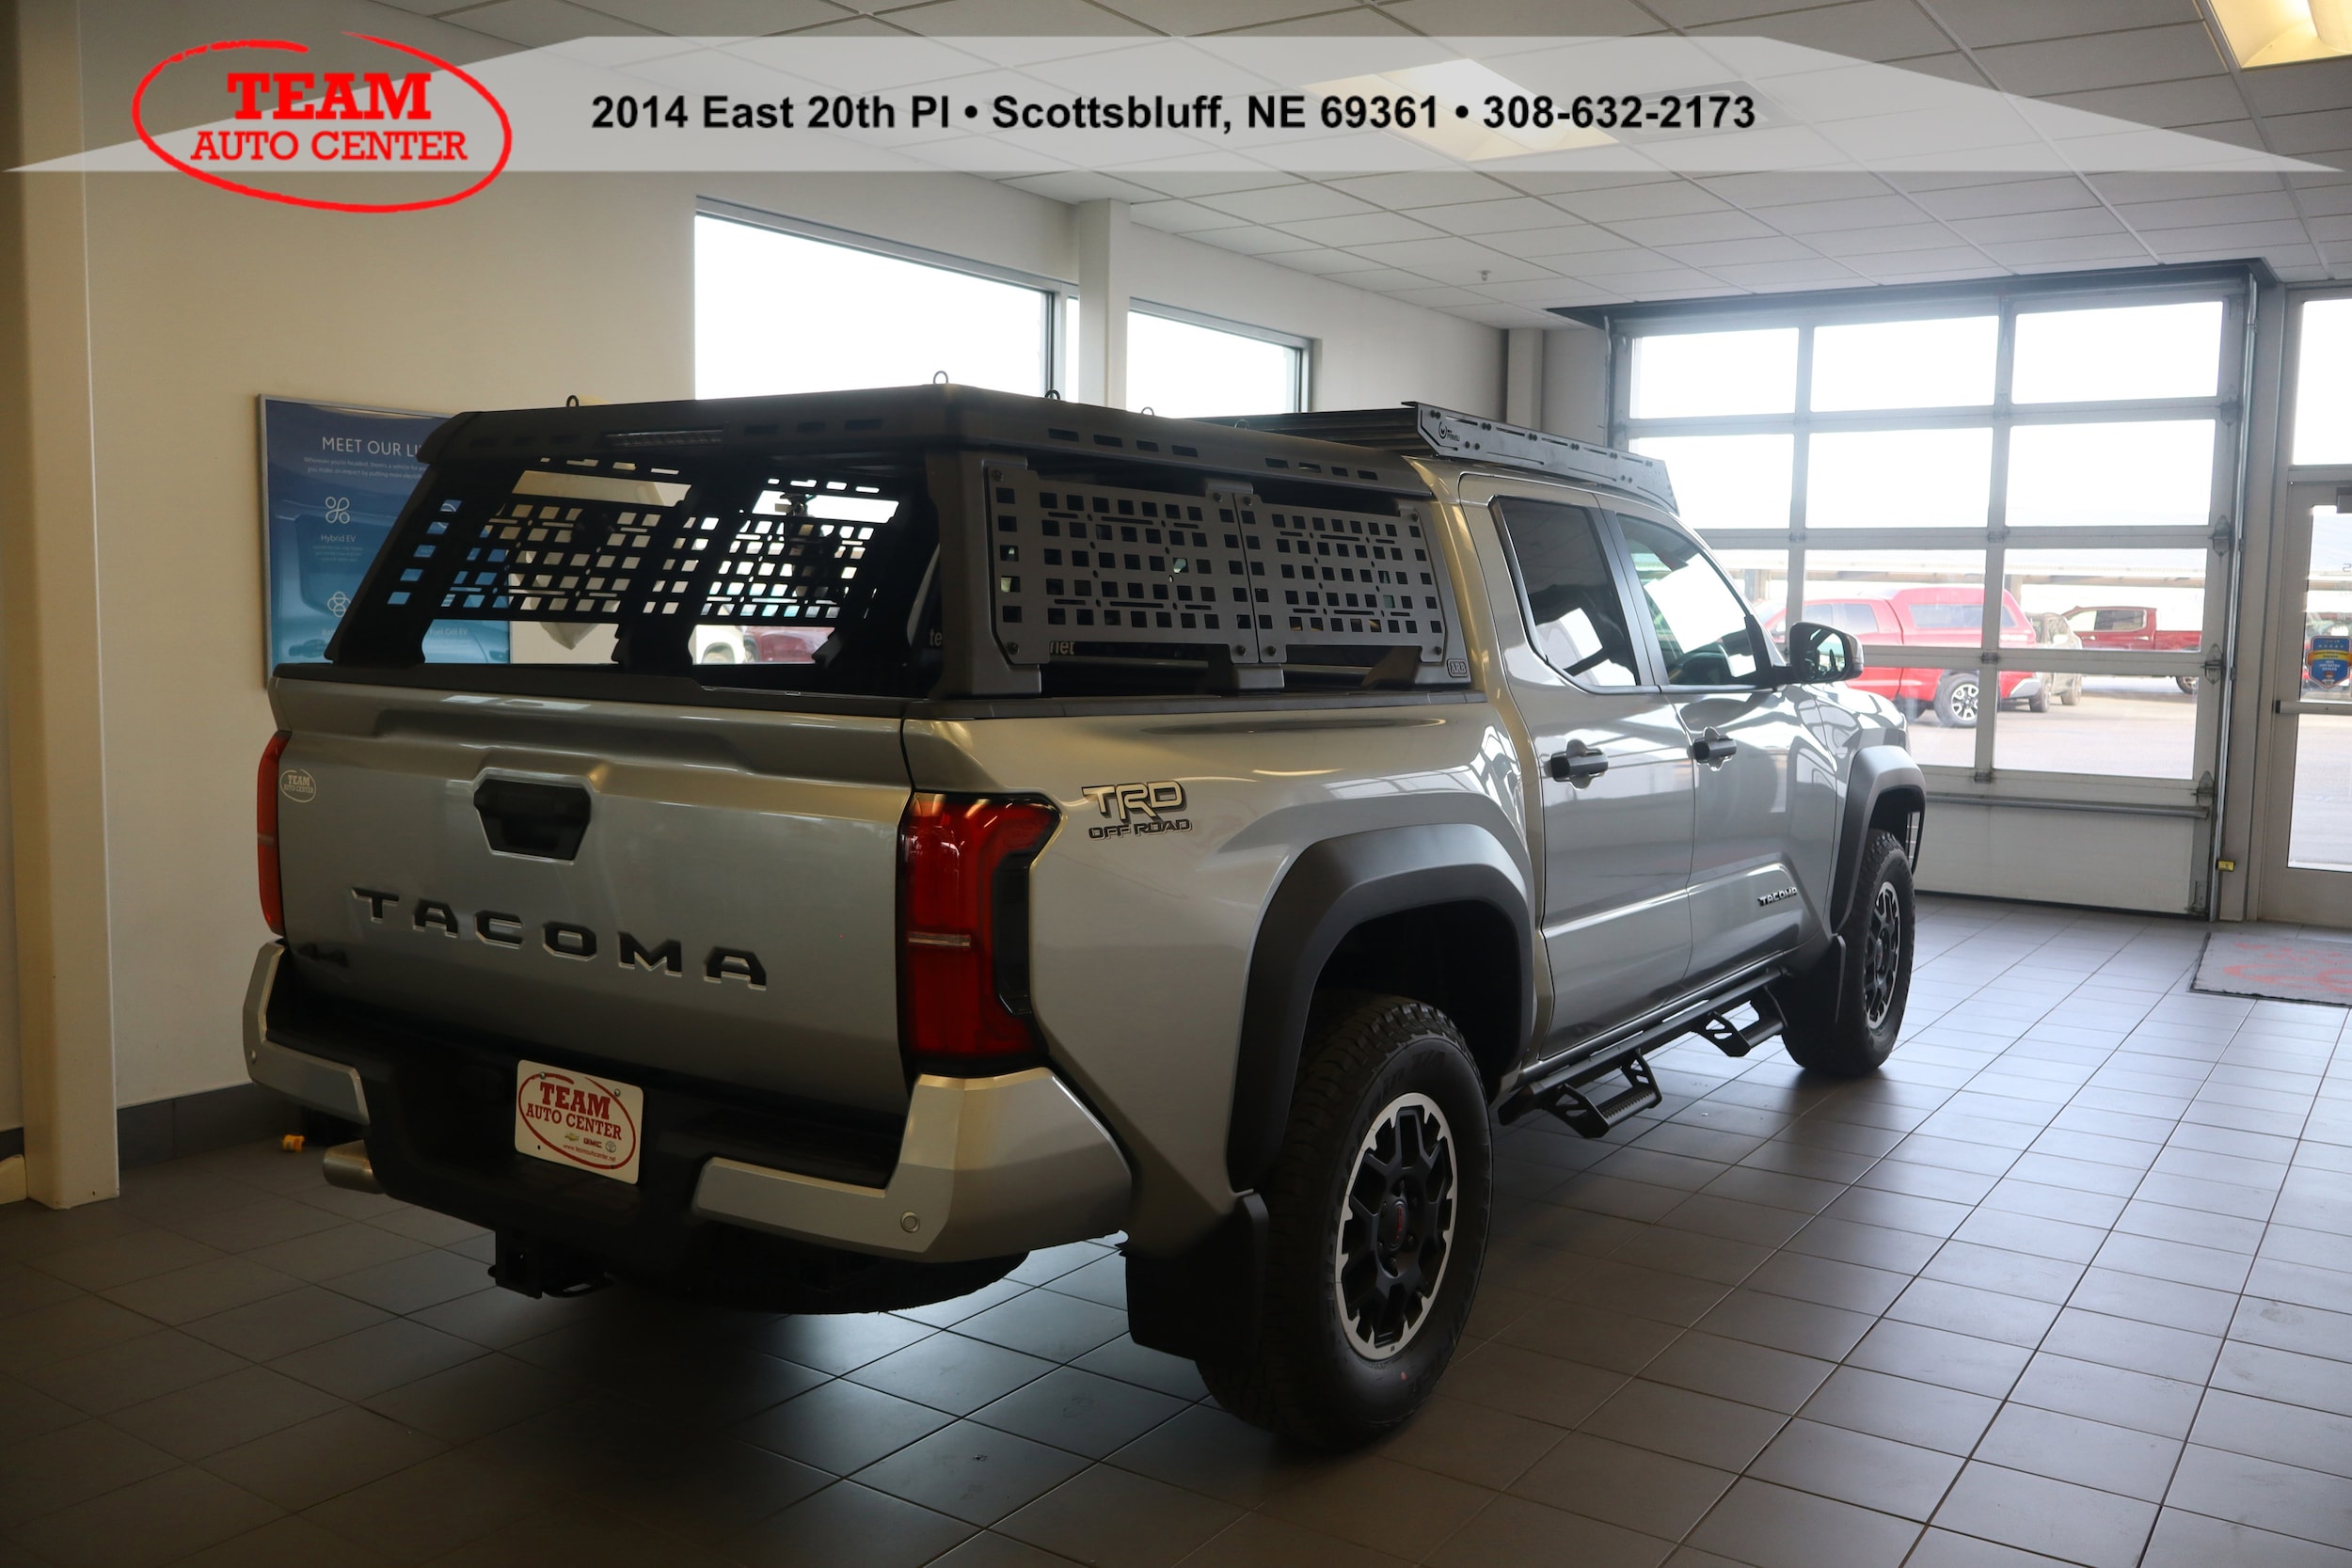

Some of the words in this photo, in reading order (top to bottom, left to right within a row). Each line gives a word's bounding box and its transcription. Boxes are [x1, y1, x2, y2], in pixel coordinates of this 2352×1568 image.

[322, 436, 362, 452] MEET
[367, 440, 402, 457] OUR
[406, 443, 422, 457] LI
[321, 533, 345, 543] Hybrid
[346, 534, 356, 543] EV
[1450, 661, 1467, 673] ARB
[287, 774, 310, 786] TEAM
[1081, 780, 1185, 822] TRD
[1089, 825, 1131, 840] OFF
[1134, 818, 1192, 836] ROAD
[1757, 887, 1798, 907] TACOMA
[352, 887, 767, 990] TACOMA
[539, 1082, 611, 1120] TEAM
[526, 1102, 562, 1124] AUTO
[565, 1113, 622, 1140] CENTER
[583, 1137, 602, 1148] GMC
